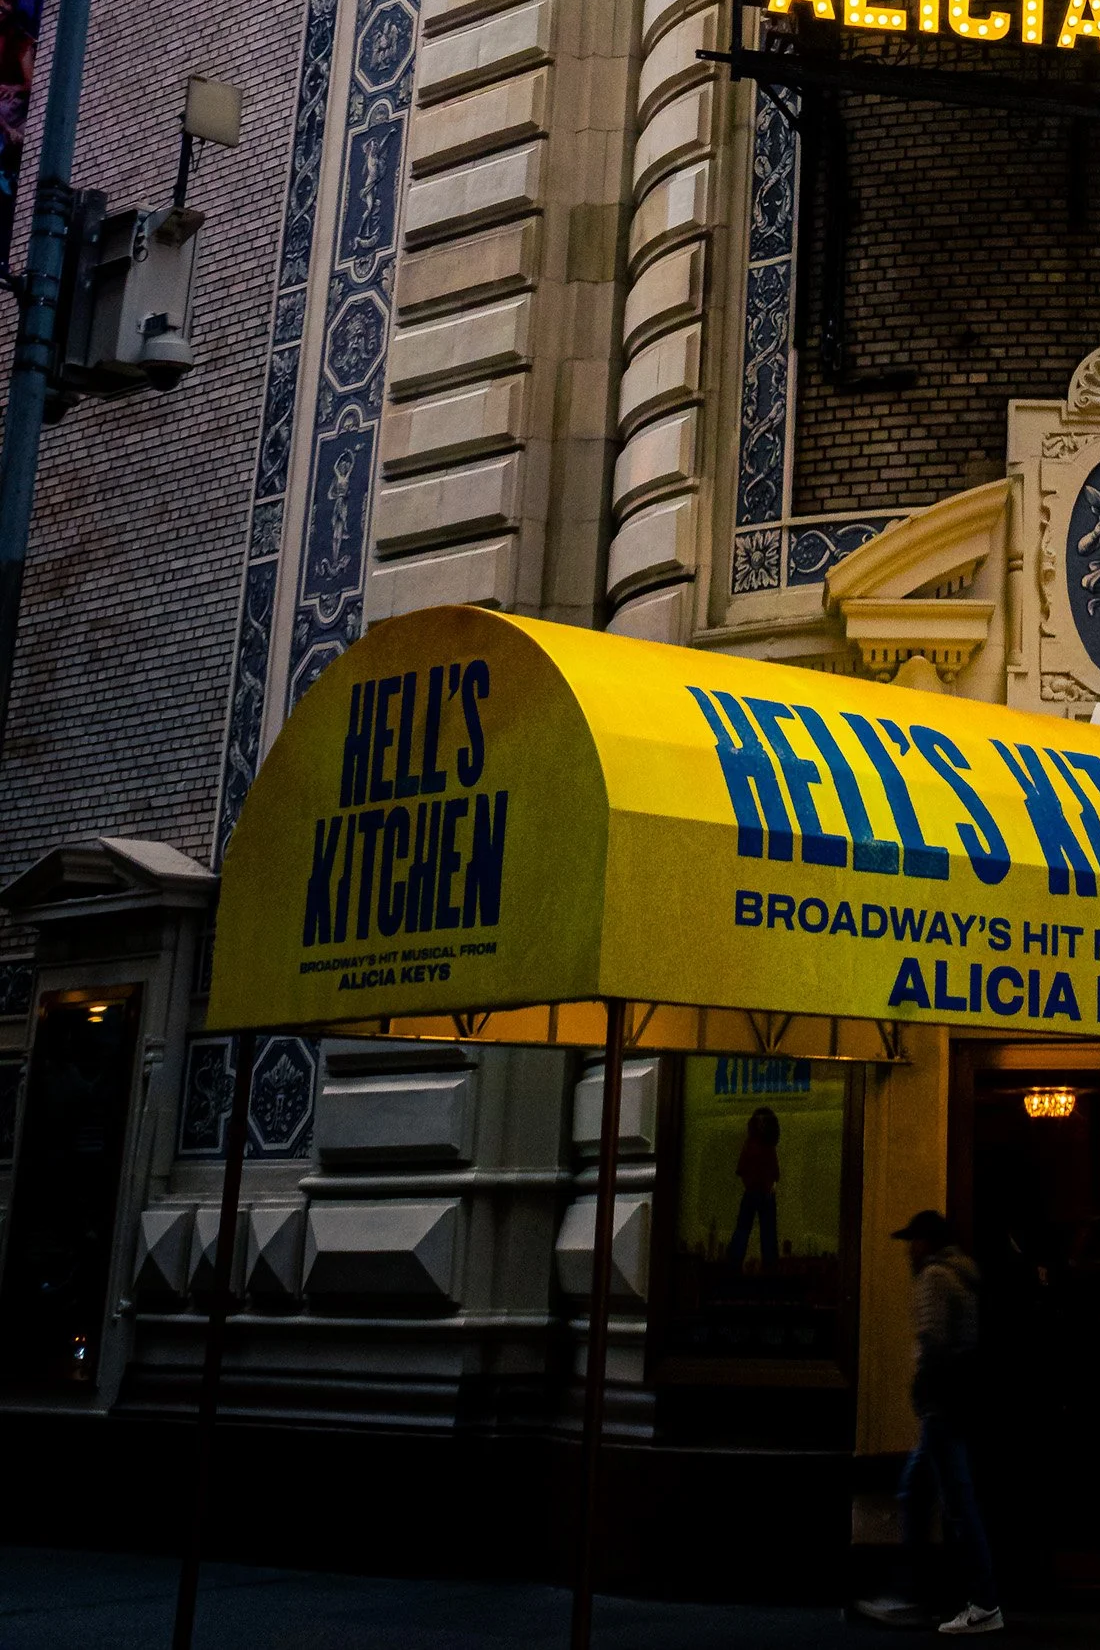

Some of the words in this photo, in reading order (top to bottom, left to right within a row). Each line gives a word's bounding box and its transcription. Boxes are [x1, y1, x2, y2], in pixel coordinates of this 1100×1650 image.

[339, 659, 490, 808] HELL'S
[686, 686, 1012, 885] HELL'S
[303, 790, 508, 947] KITCHEN
[735, 890, 1012, 951] BROADWAY'S
[1023, 920, 1084, 958] HIT
[299, 953, 376, 975] BROADWAY'S
[378, 950, 399, 965] HIT
[401, 945, 456, 962] MUSICAL
[459, 942, 497, 956] FROM
[338, 966, 396, 991] ALICIA
[400, 962, 451, 984] KEYS
[888, 957, 1082, 1022] ALICIA
